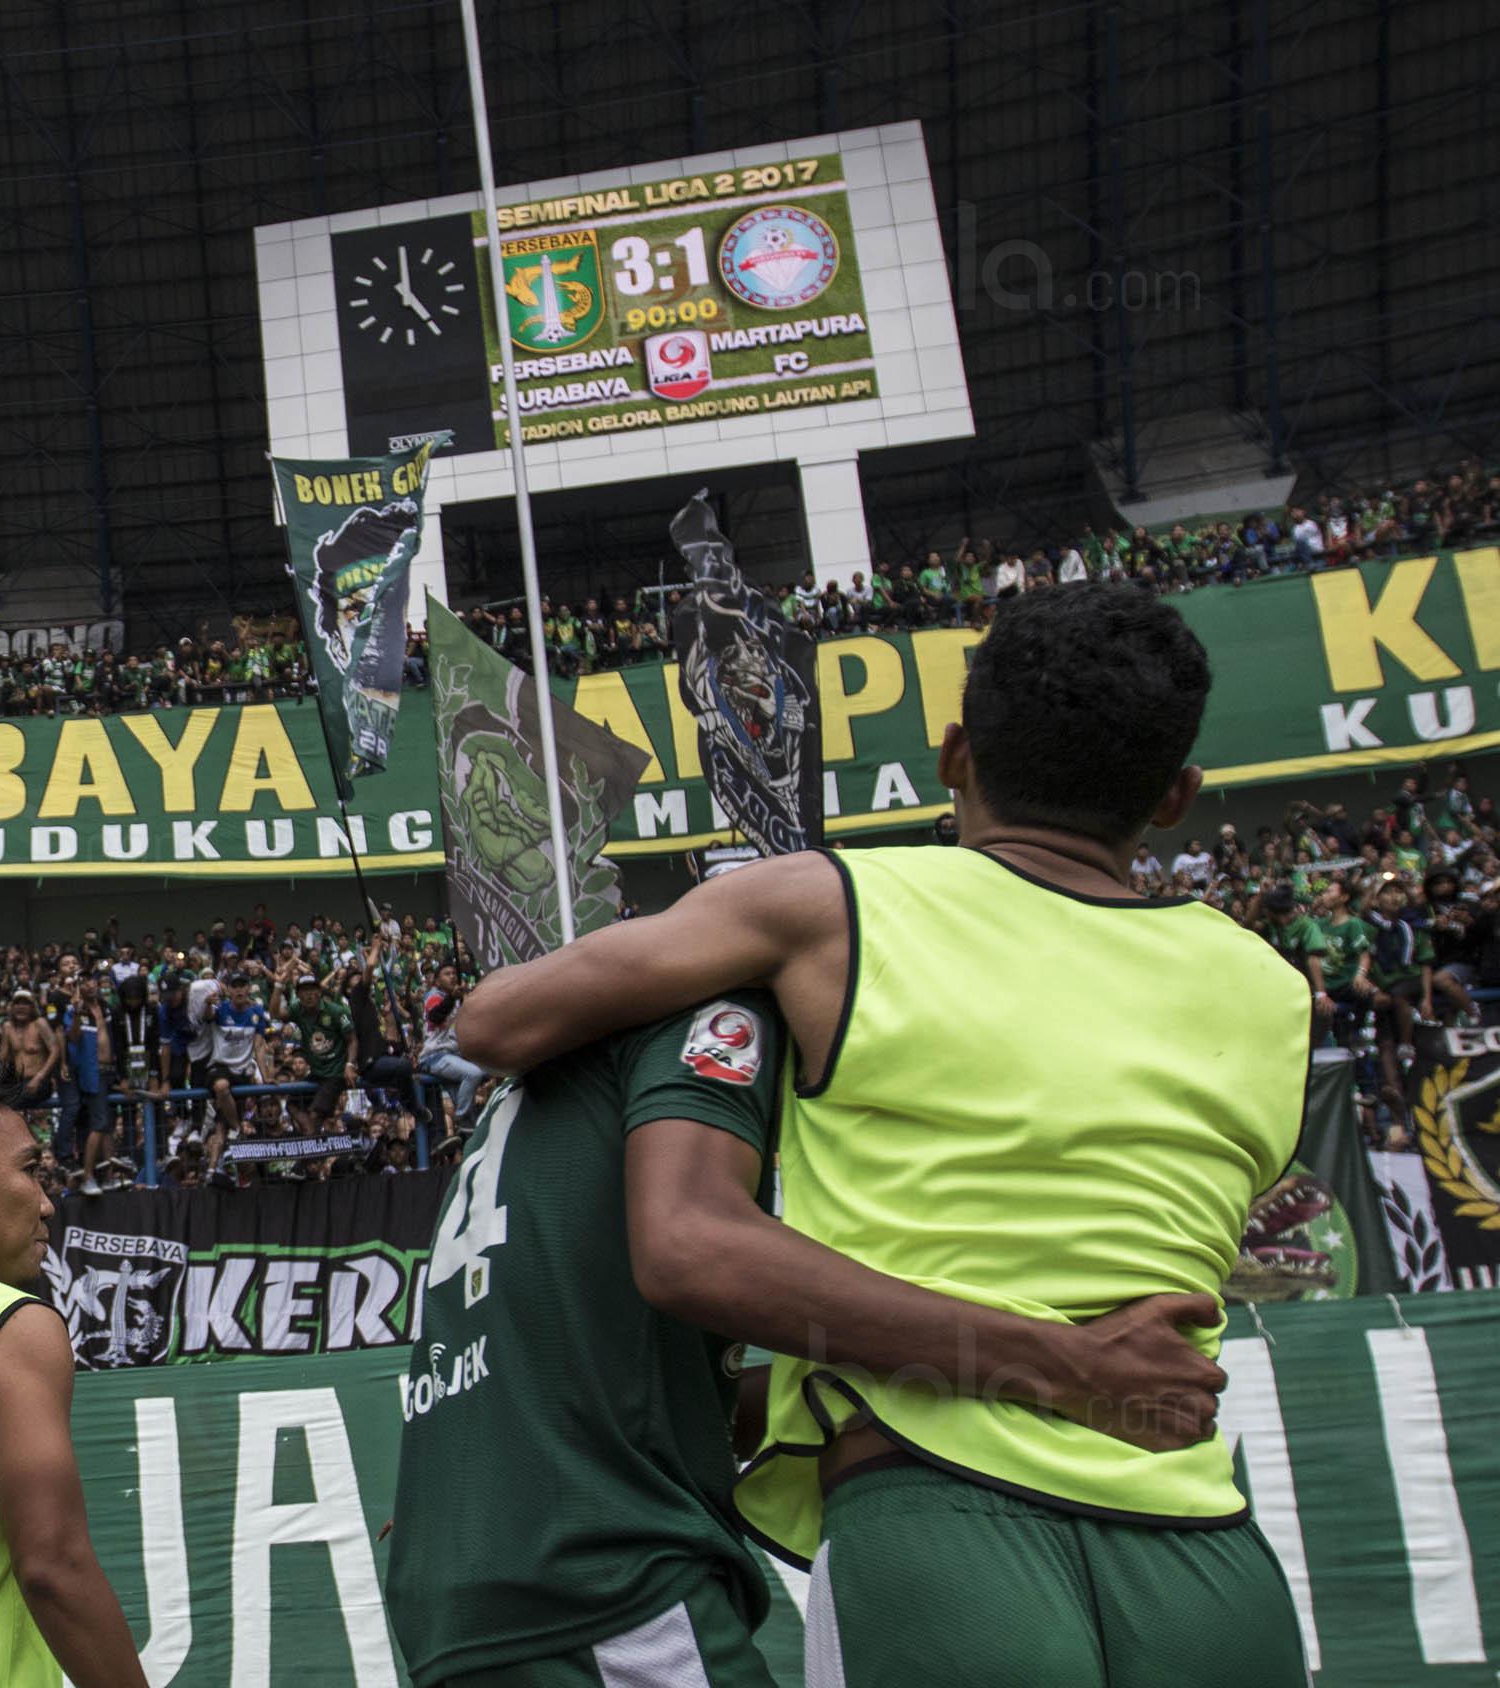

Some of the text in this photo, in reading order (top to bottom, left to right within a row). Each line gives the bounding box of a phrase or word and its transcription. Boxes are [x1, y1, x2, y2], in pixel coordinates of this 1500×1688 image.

[497, 159, 820, 229] SEMIFINAL LIGA 2 2017
[610, 226, 710, 297] 3:1
[626, 297, 719, 331] 90:00
[709, 312, 867, 353] MARTAPURA
[653, 373, 692, 385] LIGA
[773, 351, 810, 375] FC
[587, 409, 662, 432] GELORA
[665, 395, 760, 422] BANDUNG
[763, 383, 837, 409] LAUTAN
[840, 378, 873, 399] API
[293, 470, 384, 506] BONEK
[69, 1228, 185, 1263] PERSEBAYA
